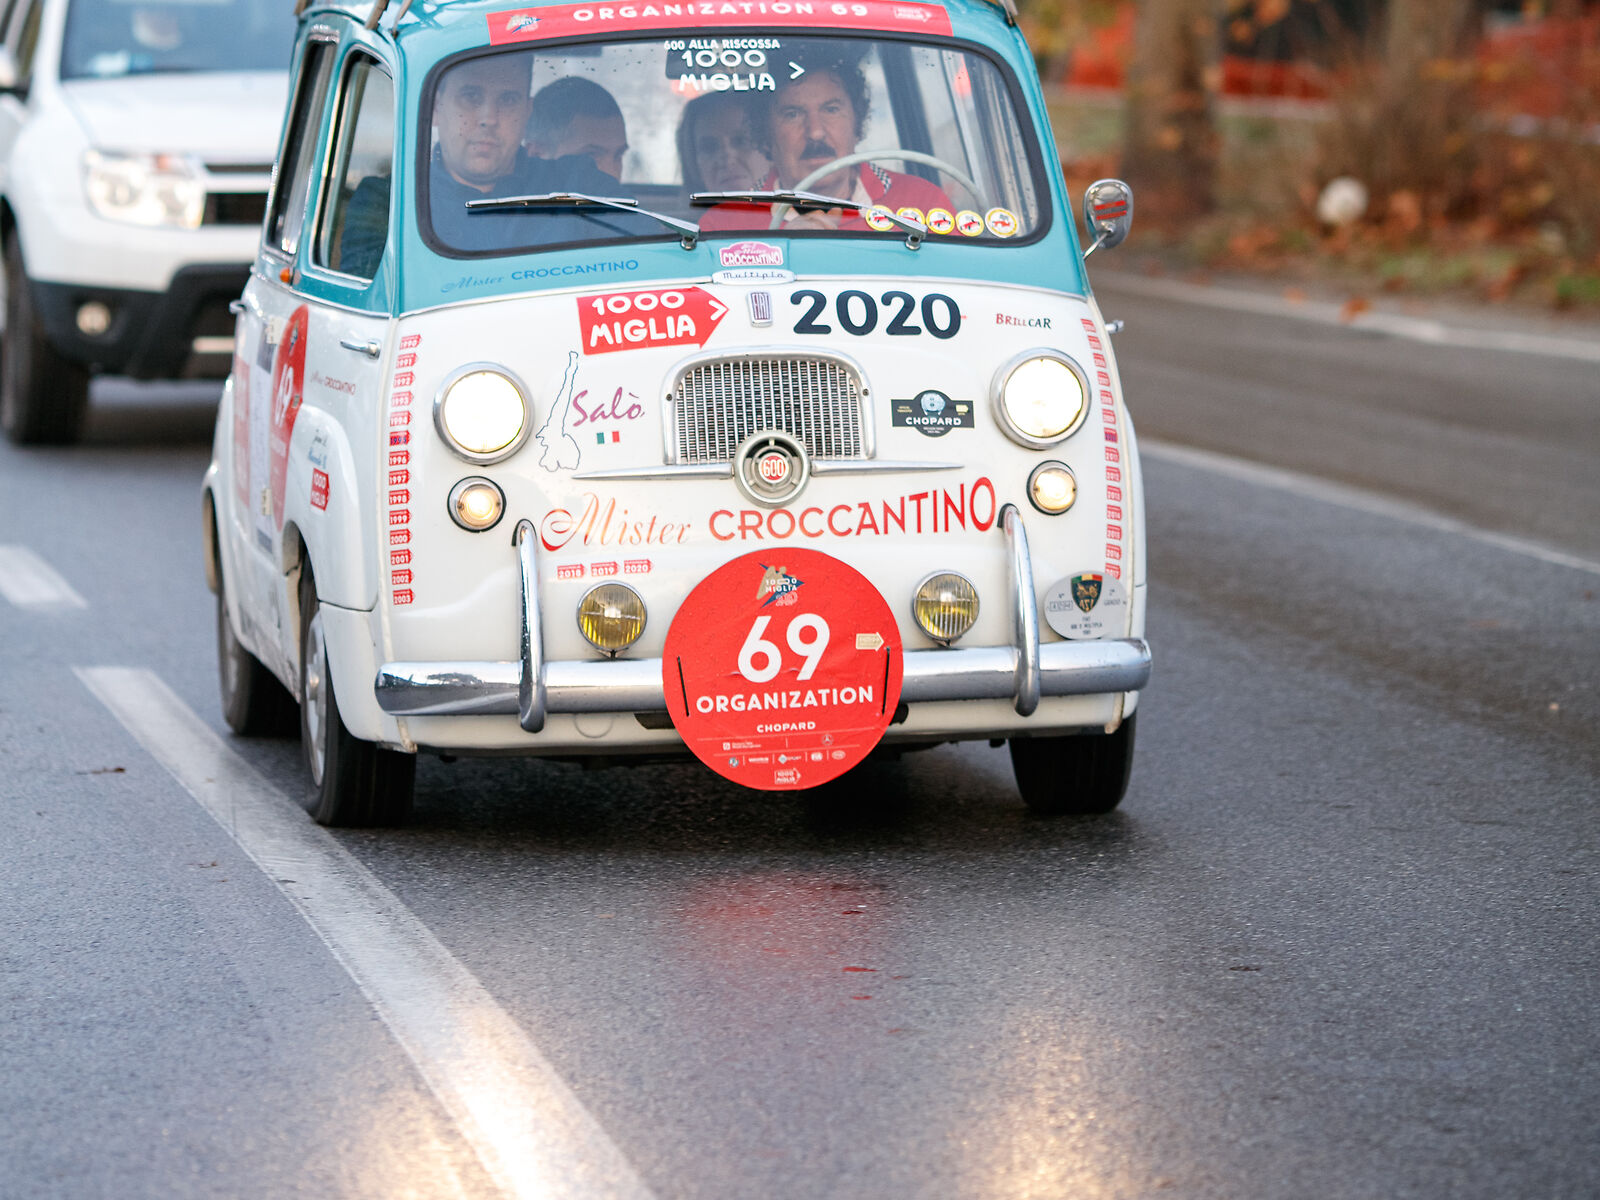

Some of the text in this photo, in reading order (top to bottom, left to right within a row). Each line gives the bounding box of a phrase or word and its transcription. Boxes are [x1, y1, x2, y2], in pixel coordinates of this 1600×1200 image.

[573, 2, 868, 21] ORGANIZATION 69
[664, 39, 781, 51] 600 ALLA RISCOSSA
[681, 50, 767, 68] 1000
[678, 72, 776, 91] MIGLIA
[723, 252, 781, 266] CROCCANTINO
[511, 259, 639, 281] CROCCANTINO
[592, 291, 685, 315] 1000
[790, 289, 961, 339] 2020
[590, 314, 696, 347] MIGLIA
[572, 386, 642, 427] Salò
[905, 416, 962, 426] CHOPARD
[763, 459, 784, 477] 600
[389, 475, 406, 485] 1997
[389, 495, 407, 504] 1998
[390, 515, 408, 524] 1999
[540, 476, 996, 552] Mister CROCCANTINO
[391, 535, 408, 544] 2000
[391, 554, 409, 564] 2001
[392, 575, 409, 584] 2002
[558, 564, 648, 578] 2018 2019 2020
[737, 613, 830, 683] 69
[696, 686, 873, 714] ORGANIZATION
[756, 721, 816, 733] CHOPARD
